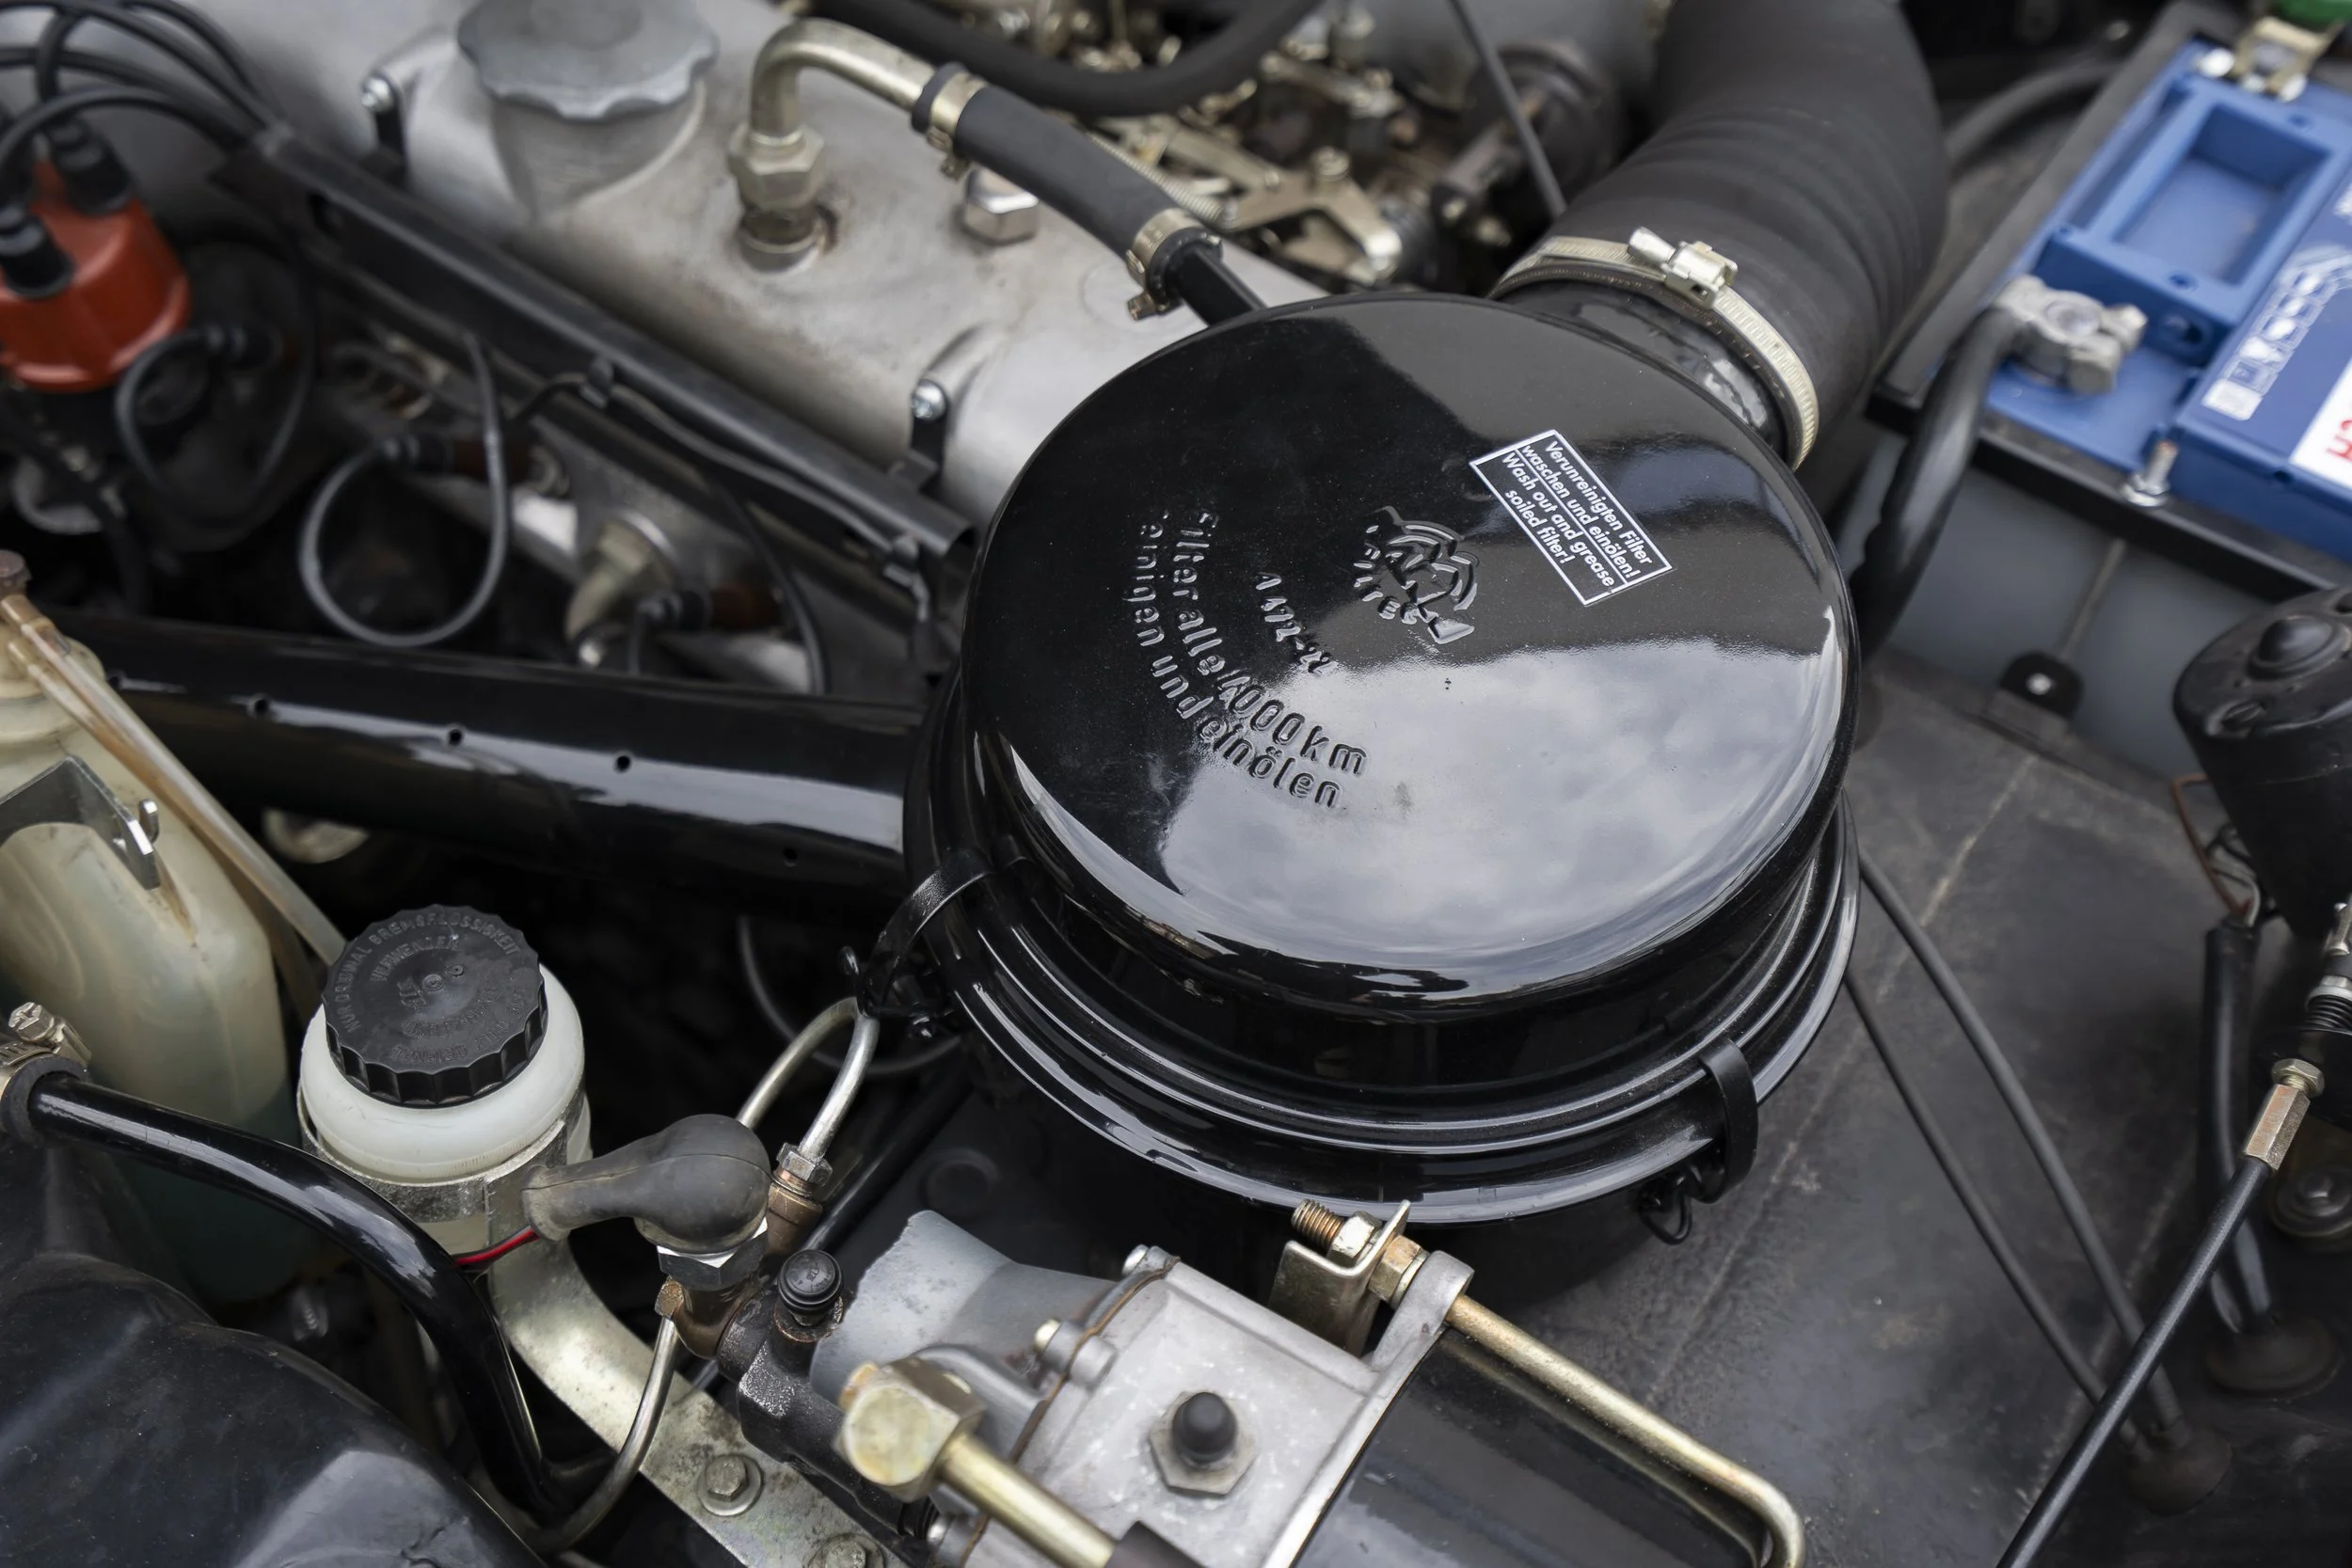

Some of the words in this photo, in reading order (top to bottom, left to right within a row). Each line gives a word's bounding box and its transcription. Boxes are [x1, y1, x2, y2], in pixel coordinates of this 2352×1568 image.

[1502, 451, 1536, 491] Wash
[1532, 490, 1558, 514] out
[1550, 513, 1583, 541] and
[1569, 540, 1615, 587] grease
[1505, 489, 1549, 528] soiled
[1536, 526, 1577, 564] filter!
[1521, 445, 1571, 499] waschen
[1566, 499, 1599, 526] und
[1588, 526, 1642, 578] einölen!
[1545, 441, 1624, 531] Verunreinigten
[1618, 530, 1653, 565] Filter
[1122, 512, 1169, 647] einigen
[1152, 656, 1216, 720] und
[1198, 717, 1341, 808] einölen
[1178, 608, 1226, 675] alle
[1299, 725, 1368, 776] km
